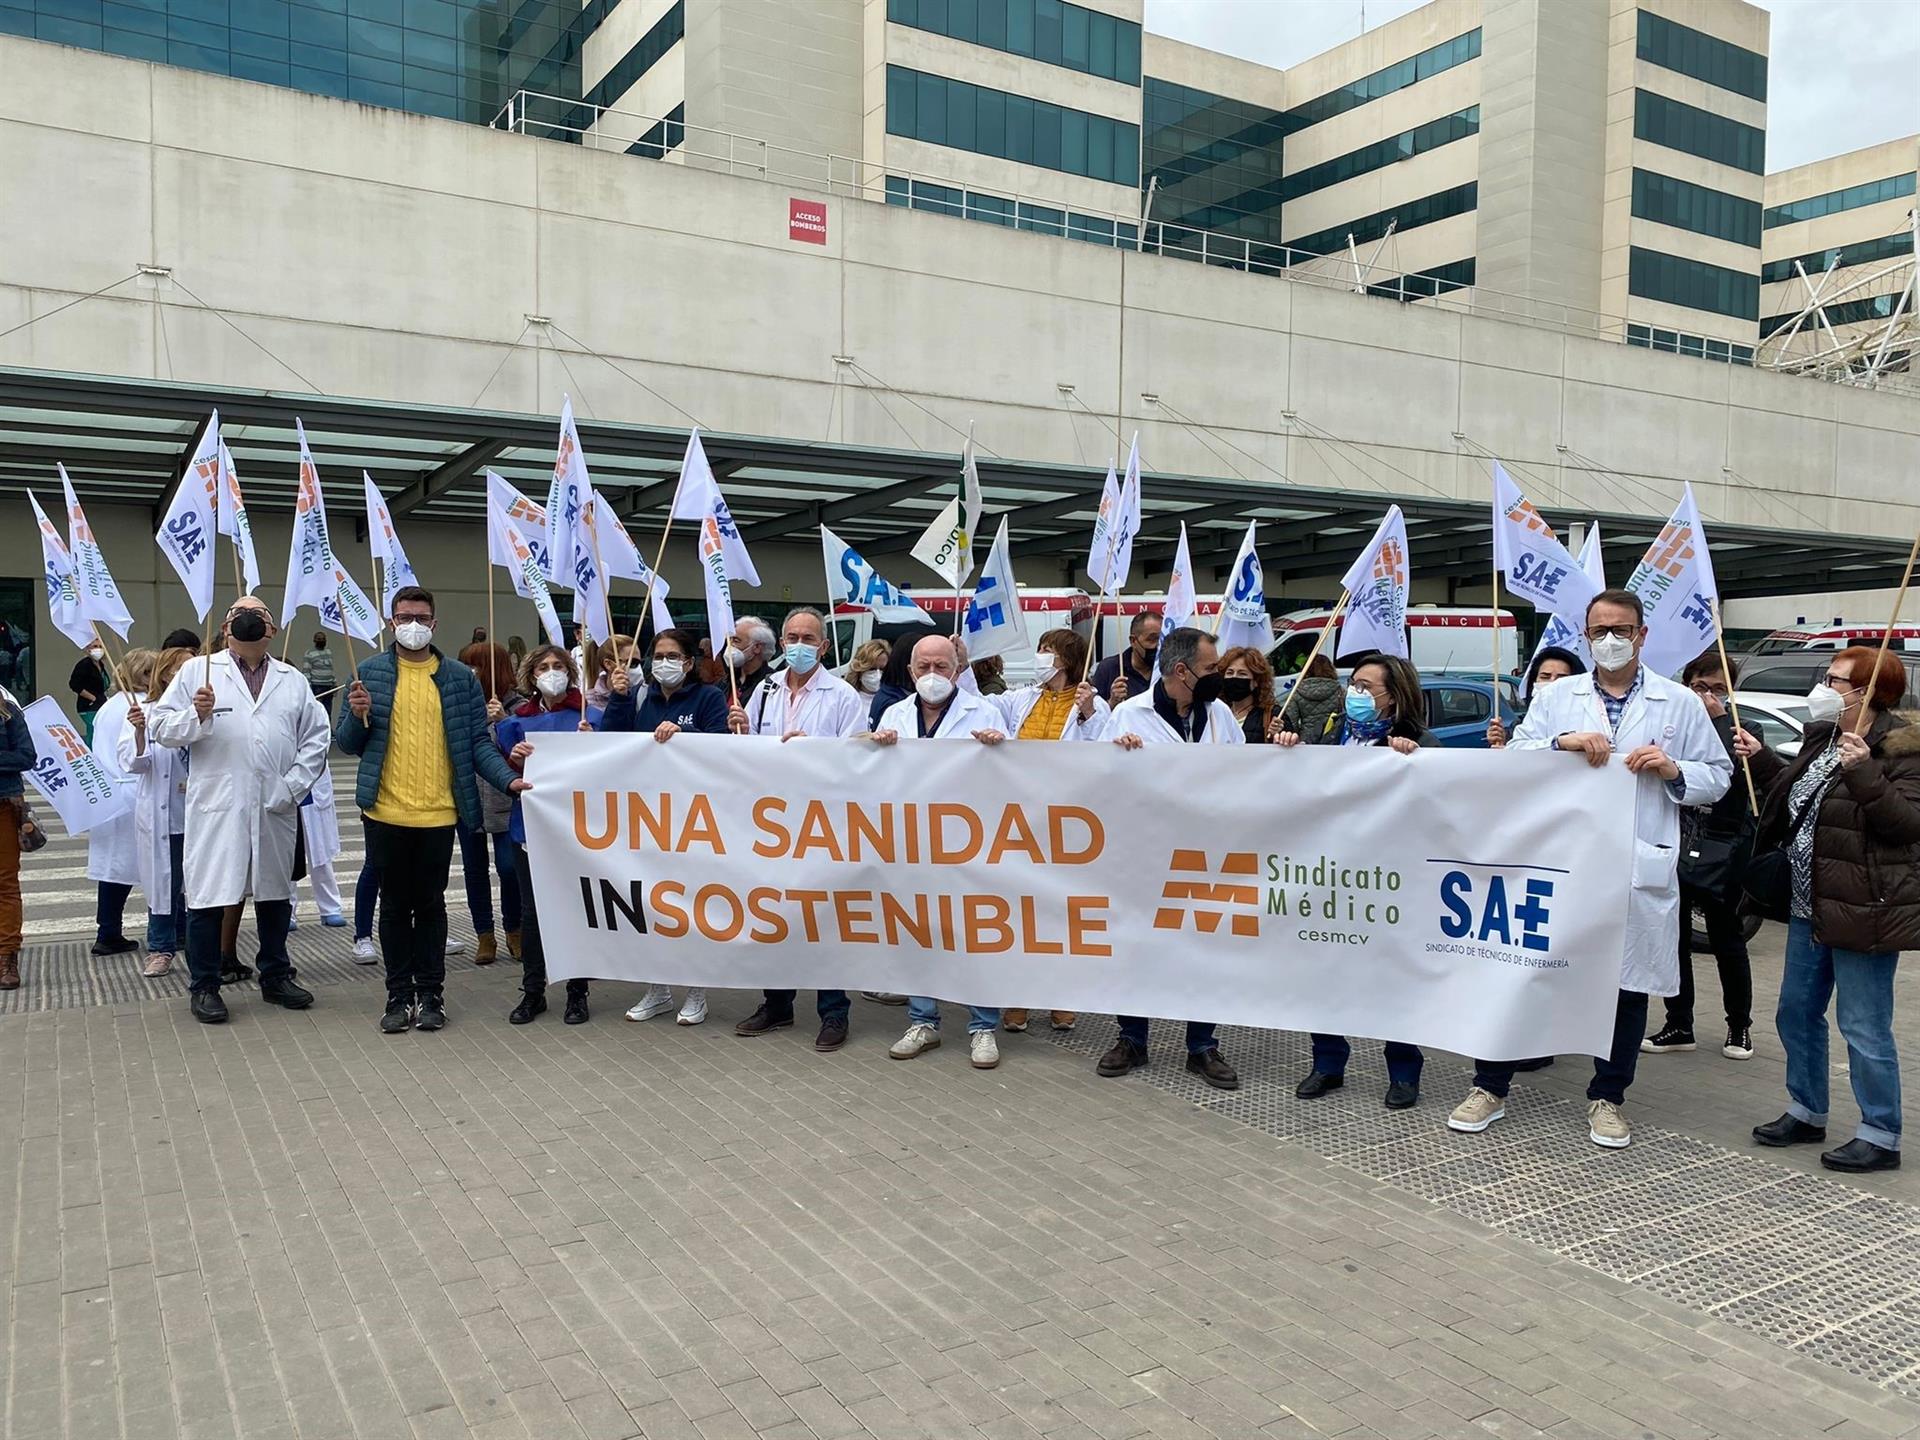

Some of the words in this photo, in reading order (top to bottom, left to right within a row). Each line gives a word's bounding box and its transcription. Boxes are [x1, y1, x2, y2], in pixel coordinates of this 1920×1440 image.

[790, 220, 825, 232] BOMBEROS
[795, 212, 821, 222] ACCESO
[337, 579, 368, 621] Sindicato
[69, 760, 98, 805] Médico
[82, 754, 112, 799] Sindicato
[572, 790, 726, 855] UNA
[751, 796, 1106, 865] SANIDAD
[1267, 853, 1401, 891] Sindicato
[579, 876, 1112, 957] INSOSTENIBLE
[1267, 886, 1400, 925] Médico
[1298, 929, 1370, 946] cesmcv
[1425, 943, 1465, 956] SINDICATO
[1466, 947, 1476, 957] DE
[1478, 948, 1512, 964] TÉCNICOS
[1513, 953, 1523, 963] DE
[1524, 955, 1569, 969] ENFERMERÍA
